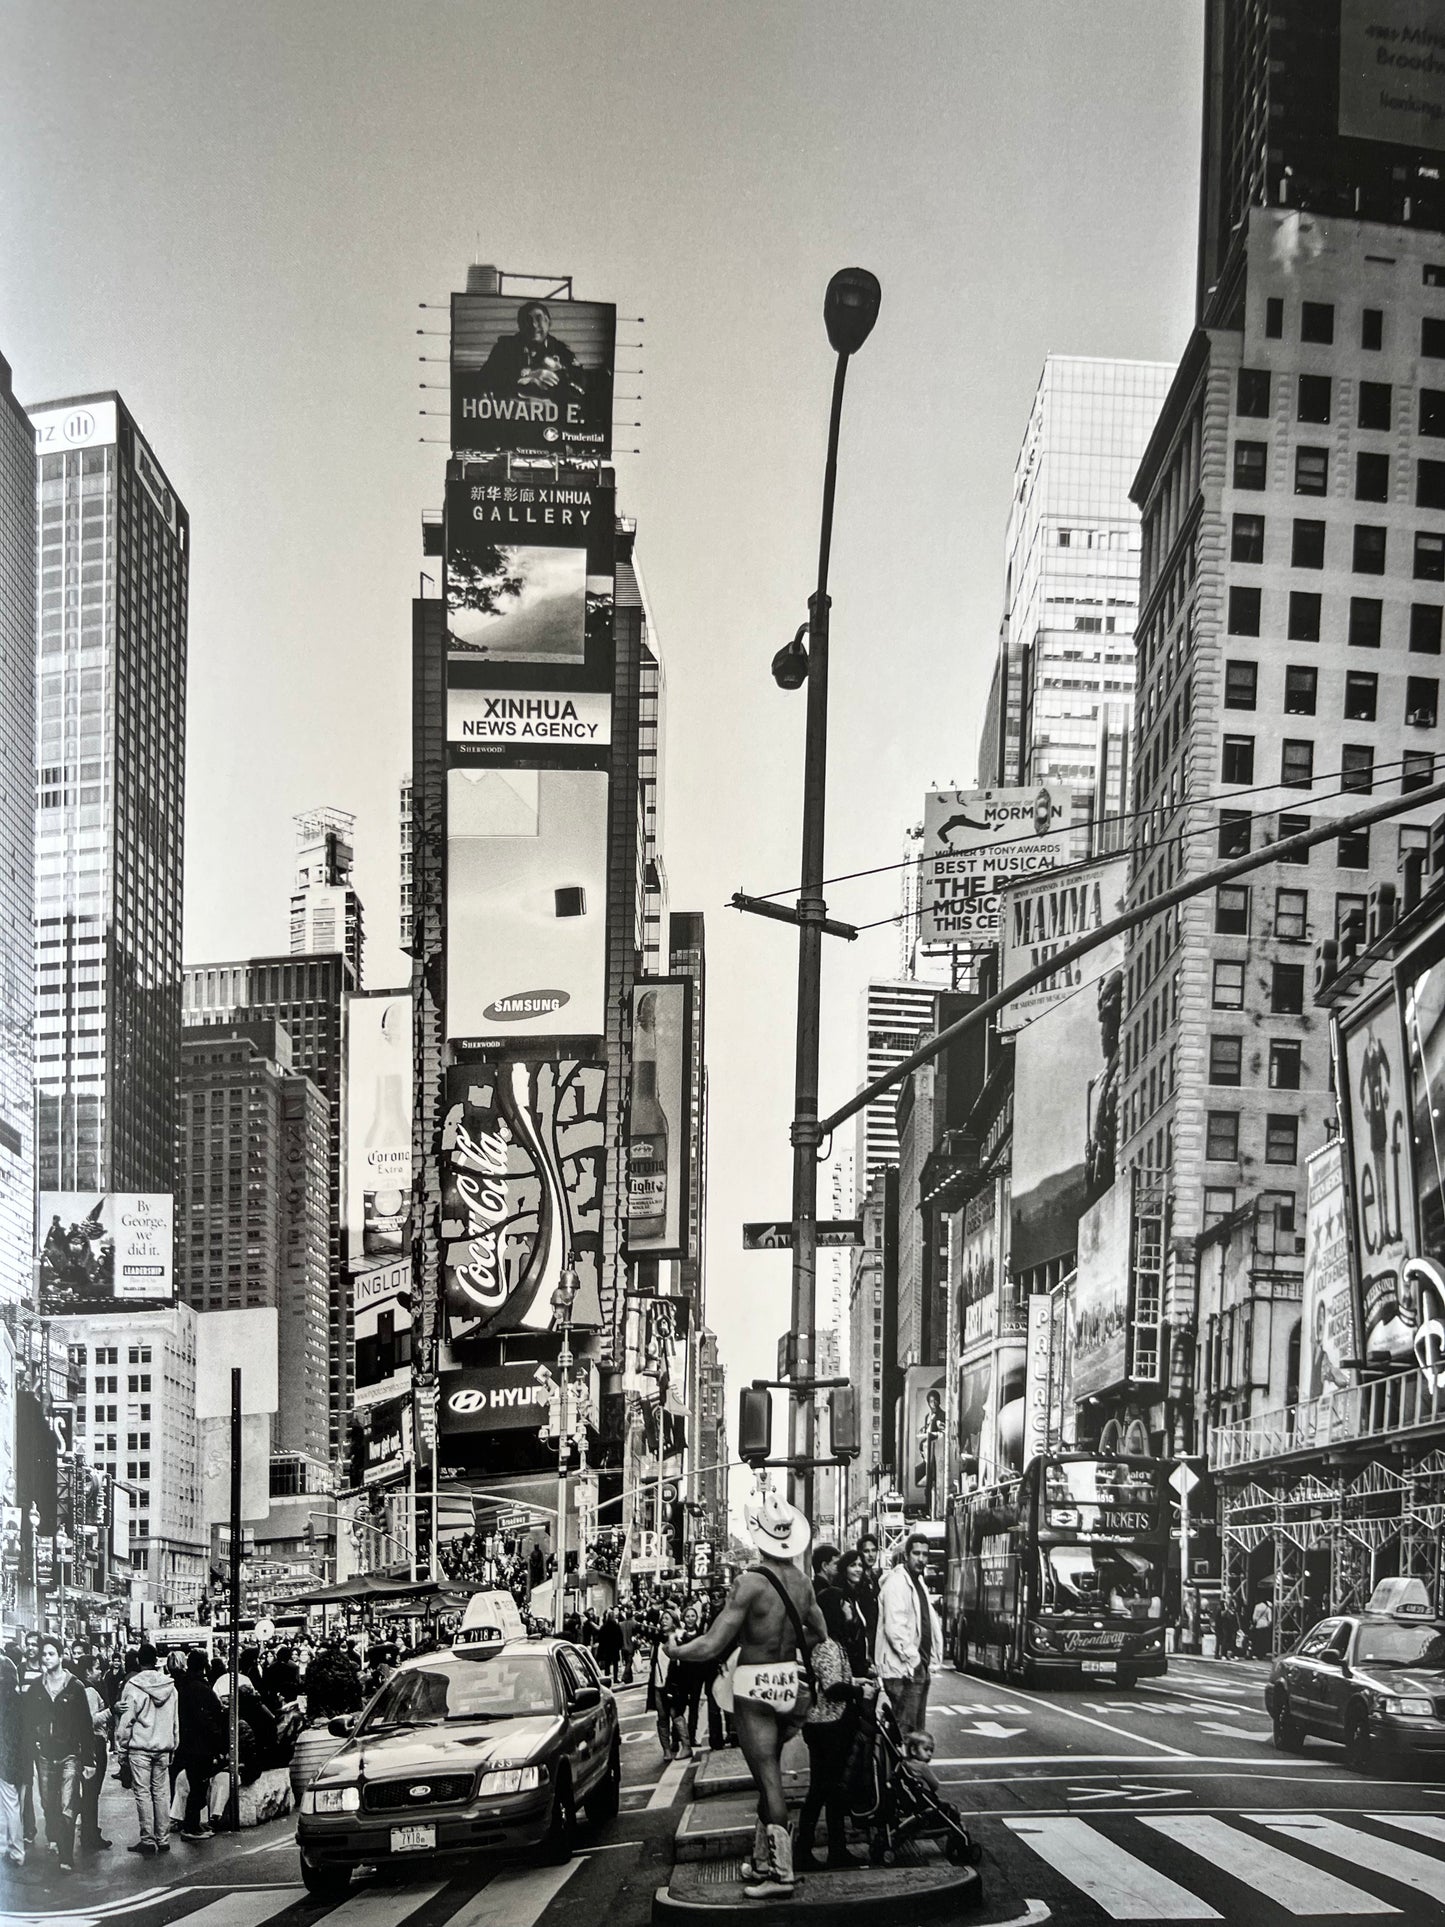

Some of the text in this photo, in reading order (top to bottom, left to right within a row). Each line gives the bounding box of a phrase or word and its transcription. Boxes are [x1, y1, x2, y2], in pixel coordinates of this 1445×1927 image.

[462, 398, 585, 424] HOWARD E.
[562, 431, 604, 442] Prudential
[470, 486, 592, 505] 新华影廊 XINHUA
[472, 505, 591, 526] GALLERY
[484, 698, 578, 721] XINHUA
[462, 720, 599, 738] NEWS AGENCY
[980, 848, 986, 857] 9
[989, 845, 1017, 855] TONY
[1017, 844, 1061, 854] AWARDS
[934, 857, 1056, 875] BEST MUSICAL
[933, 897, 1002, 917] MUSIC
[1011, 881, 1103, 949] MAMMA
[933, 915, 972, 932] THIS
[494, 998, 560, 1013] SAMSUNG
[462, 1040, 501, 1049] SHERWOOD
[629, 1160, 666, 1173] orona
[137, 1200, 151, 1215] By
[121, 1213, 168, 1231] George,
[136, 1231, 152, 1240] we
[127, 1242, 160, 1256] did it.
[357, 1266, 410, 1299] INGLOT
[1031, 1308, 1049, 1457] PALACE
[1104, 1511, 1150, 1529] TICKETS
[695, 1542, 711, 1577] tkts
[470, 1629, 489, 1642] 7Y18
[1063, 1630, 1125, 1652] Broadway
